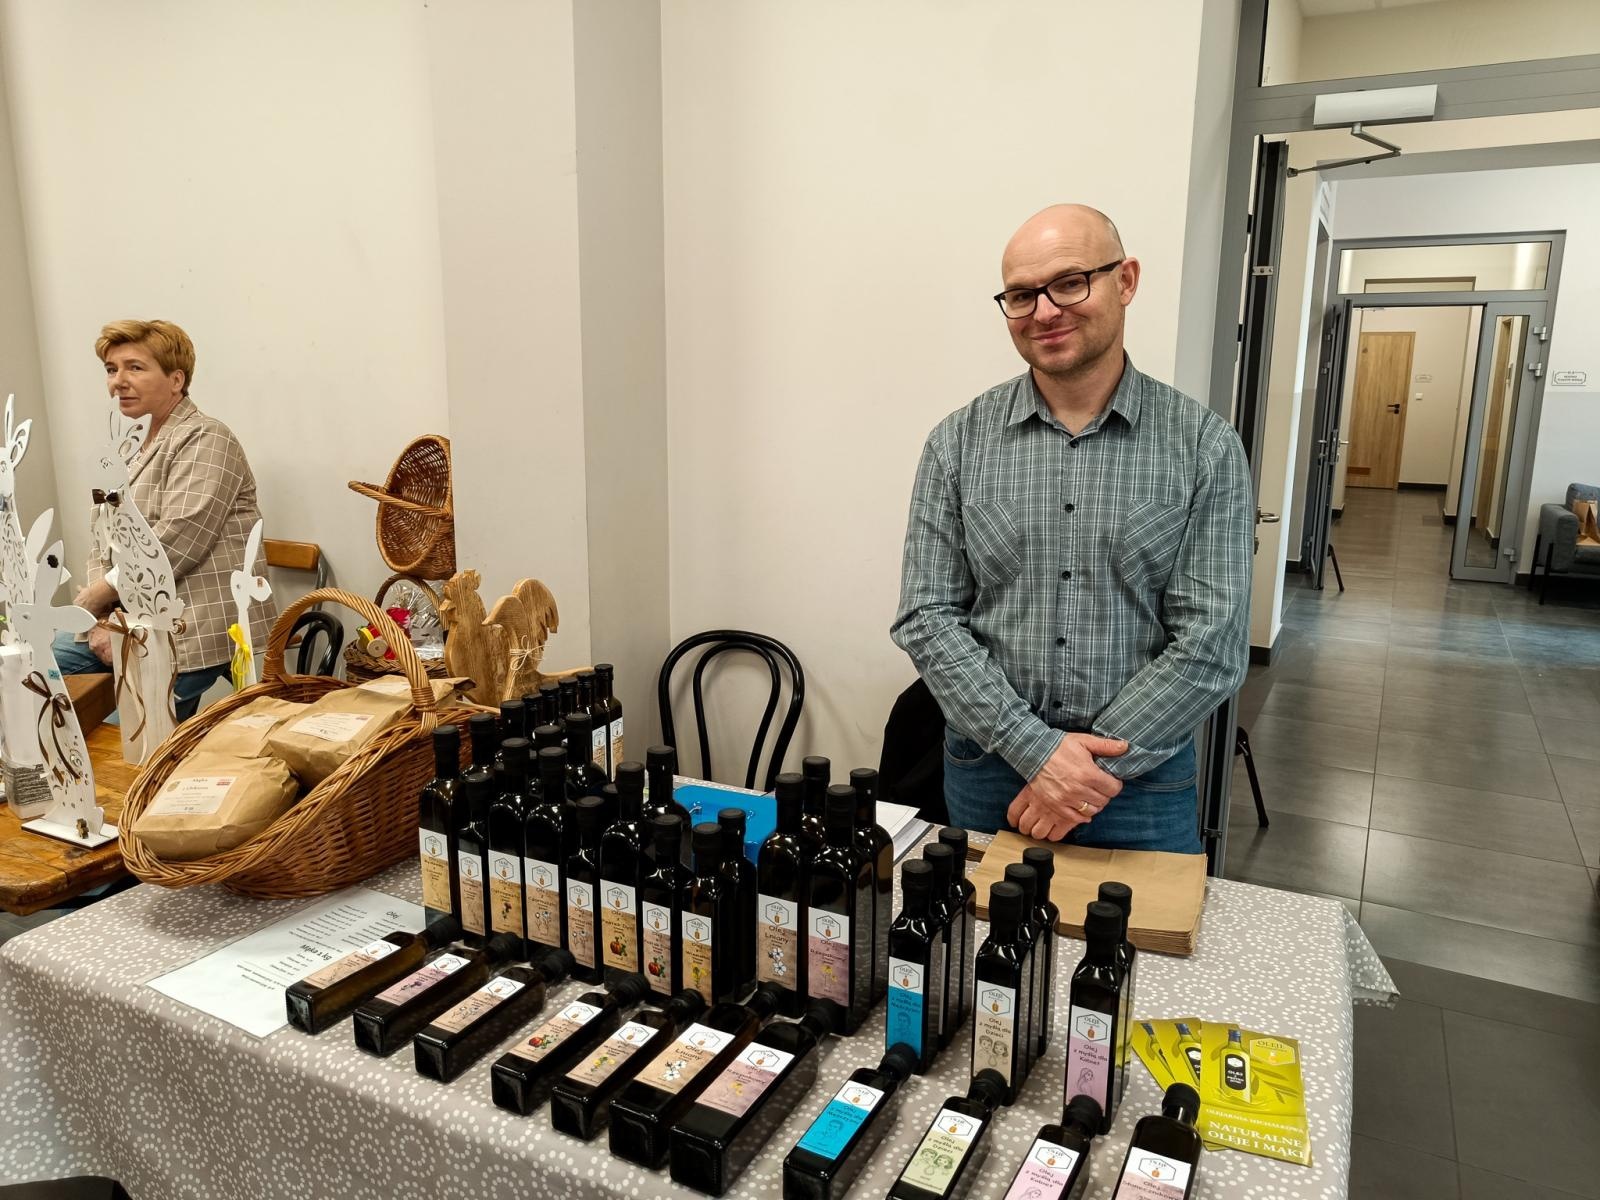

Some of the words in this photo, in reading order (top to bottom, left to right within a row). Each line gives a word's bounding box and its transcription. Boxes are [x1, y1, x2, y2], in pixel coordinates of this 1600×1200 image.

[768, 925, 786, 936] Olej
[764, 932, 788, 944] Lniany
[321, 952, 332, 961] kg
[989, 1018, 1002, 1026] Olej
[1084, 1016, 1099, 1025] OLEJE
[1084, 1044, 1098, 1053] Olej
[1257, 1040, 1284, 1049] OLEJE
[675, 1048, 703, 1060] Lniany
[685, 1045, 704, 1055] Olej
[1080, 1056, 1100, 1065] Kobiet
[1208, 1130, 1249, 1147] OLEJE
[1254, 1140, 1259, 1148] I
[1209, 1121, 1302, 1148] NATURALNE
[940, 1135, 955, 1144] Olej
[1039, 1168, 1054, 1178] Olej
[1144, 1181, 1161, 1190] Olej
